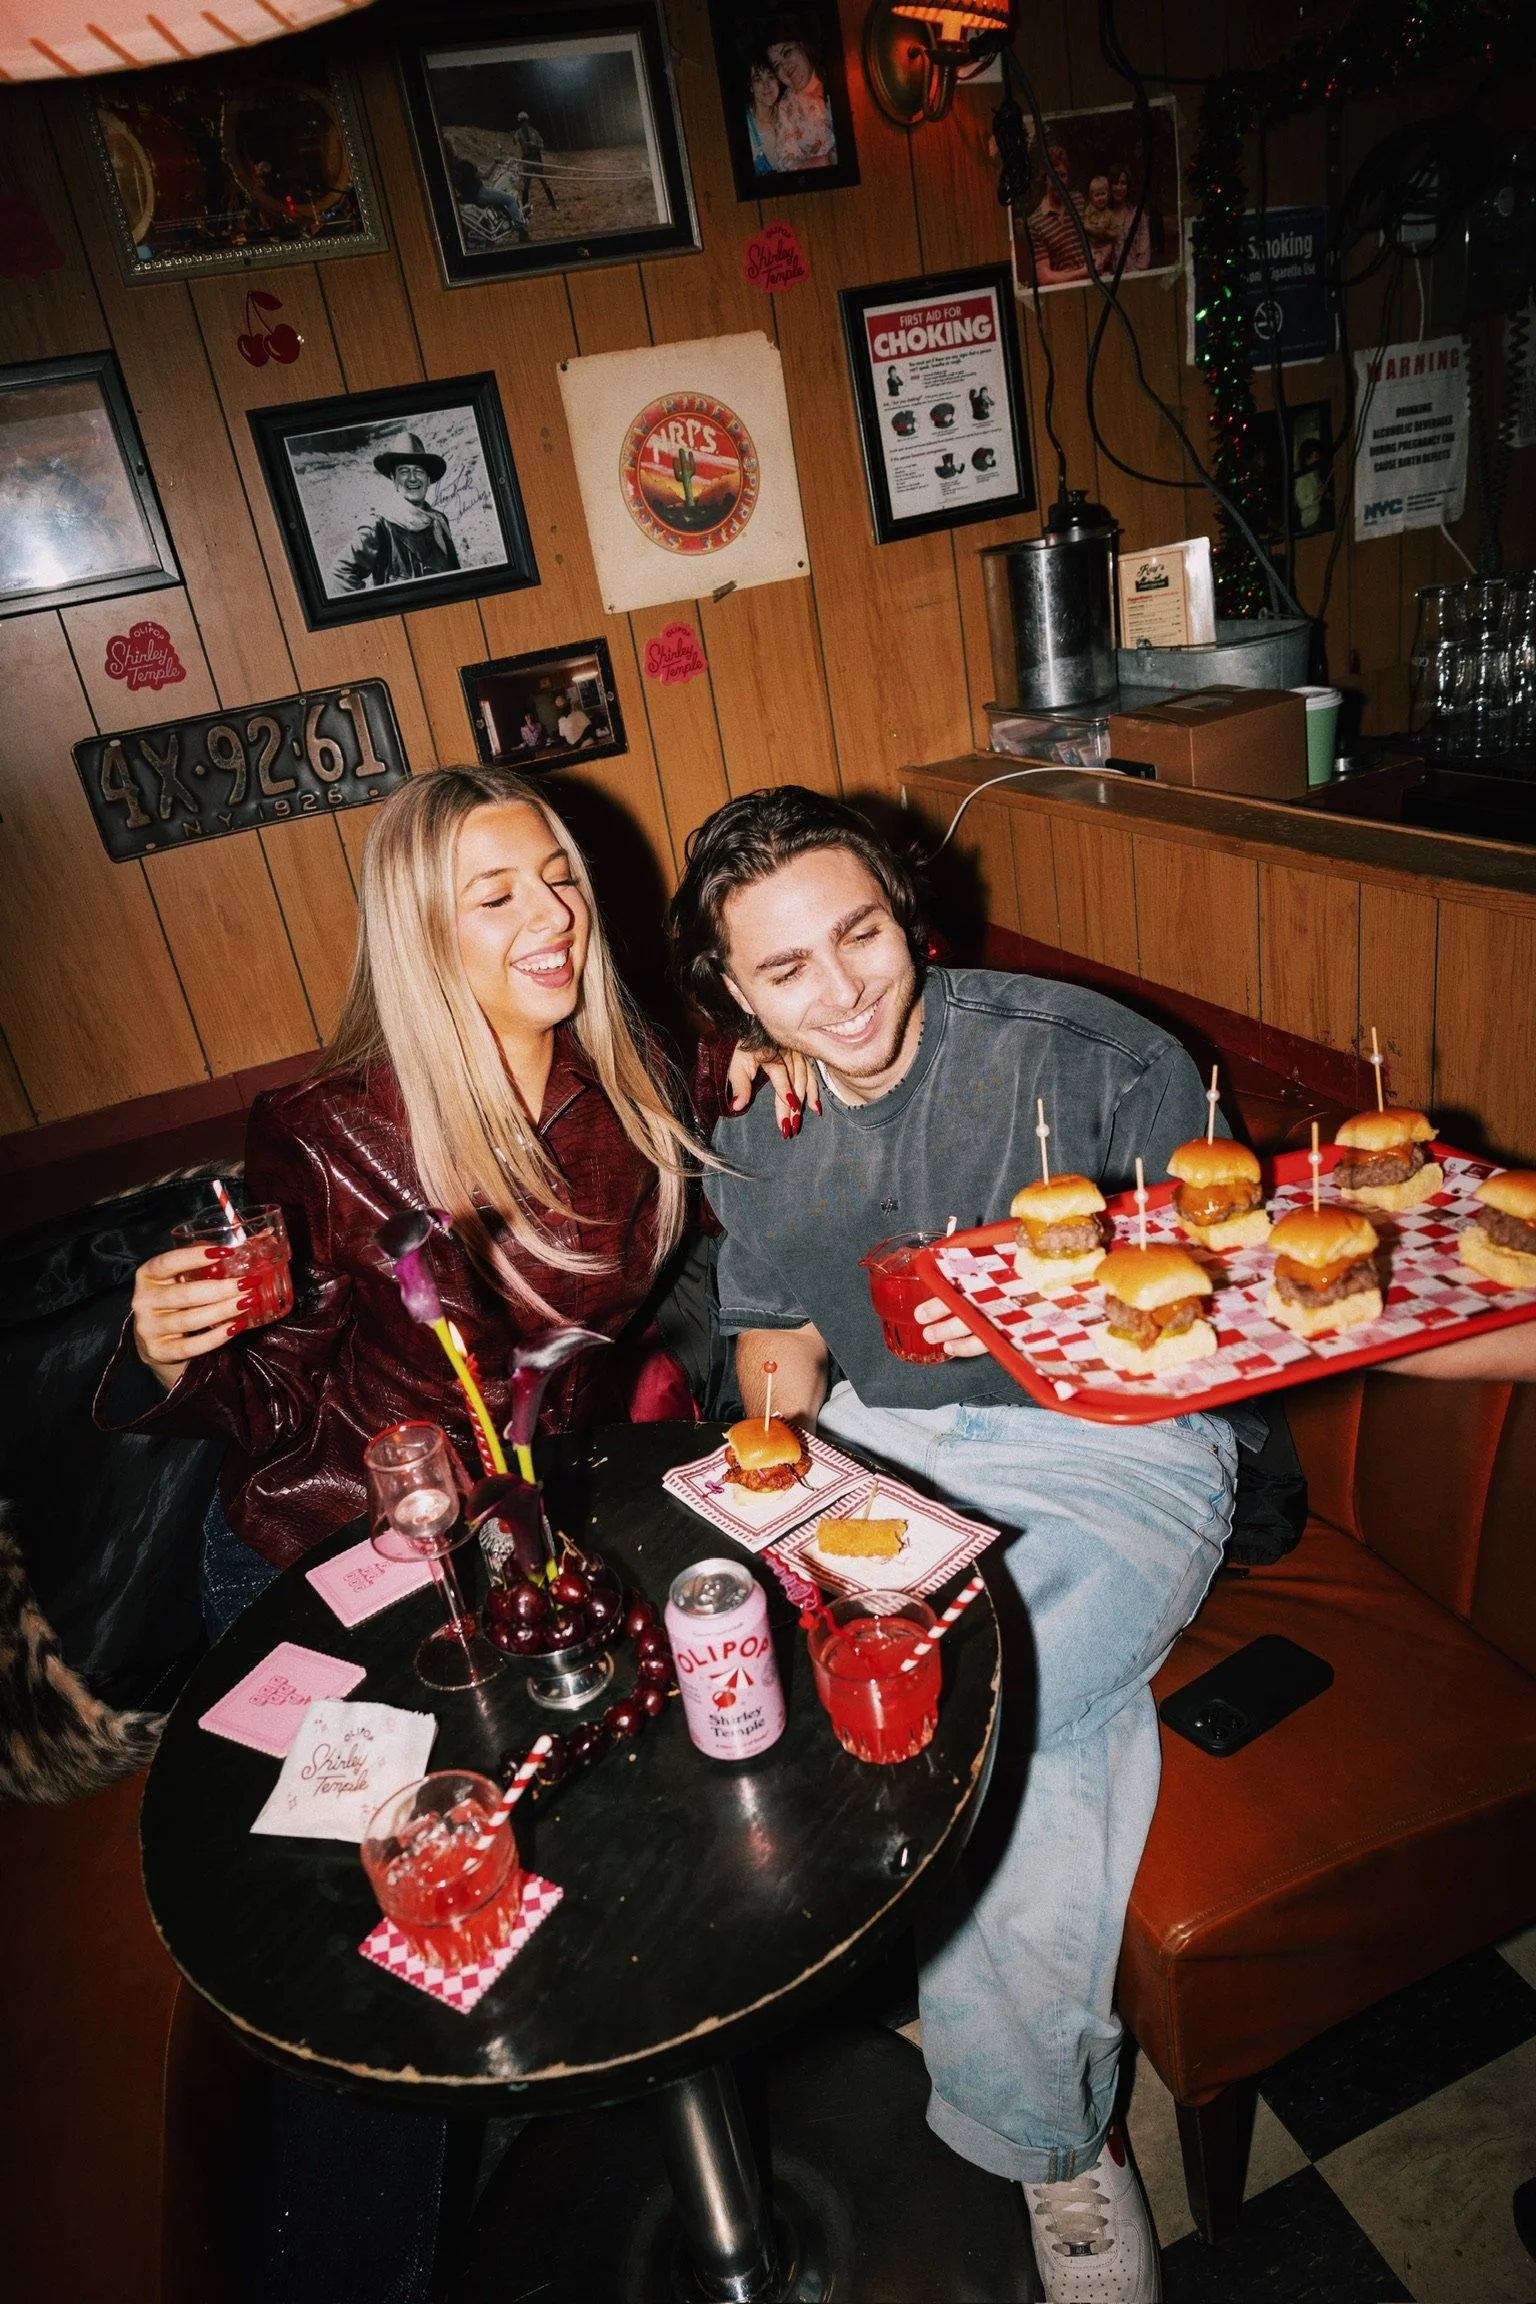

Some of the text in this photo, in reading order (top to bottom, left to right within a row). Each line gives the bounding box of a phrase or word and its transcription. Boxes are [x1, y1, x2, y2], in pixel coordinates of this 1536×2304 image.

[747, 238, 795, 279] Shirley
[761, 254, 805, 289] Temple
[900, 305, 962, 328] FIRST AID FOR
[873, 314, 992, 358] CHOKING
[1367, 348, 1459, 383] WARNING
[1364, 498, 1403, 521] NYC
[110, 638, 169, 675] Shirley
[127, 656, 180, 686] Temple
[647, 637, 694, 673] Shirley
[661, 650, 704, 681] Temple
[257, 788, 344, 820] 1926
[677, 1635, 770, 1674] OLIPOP
[300, 1742, 368, 1781] Shirley
[312, 1768, 369, 1798] Temple
